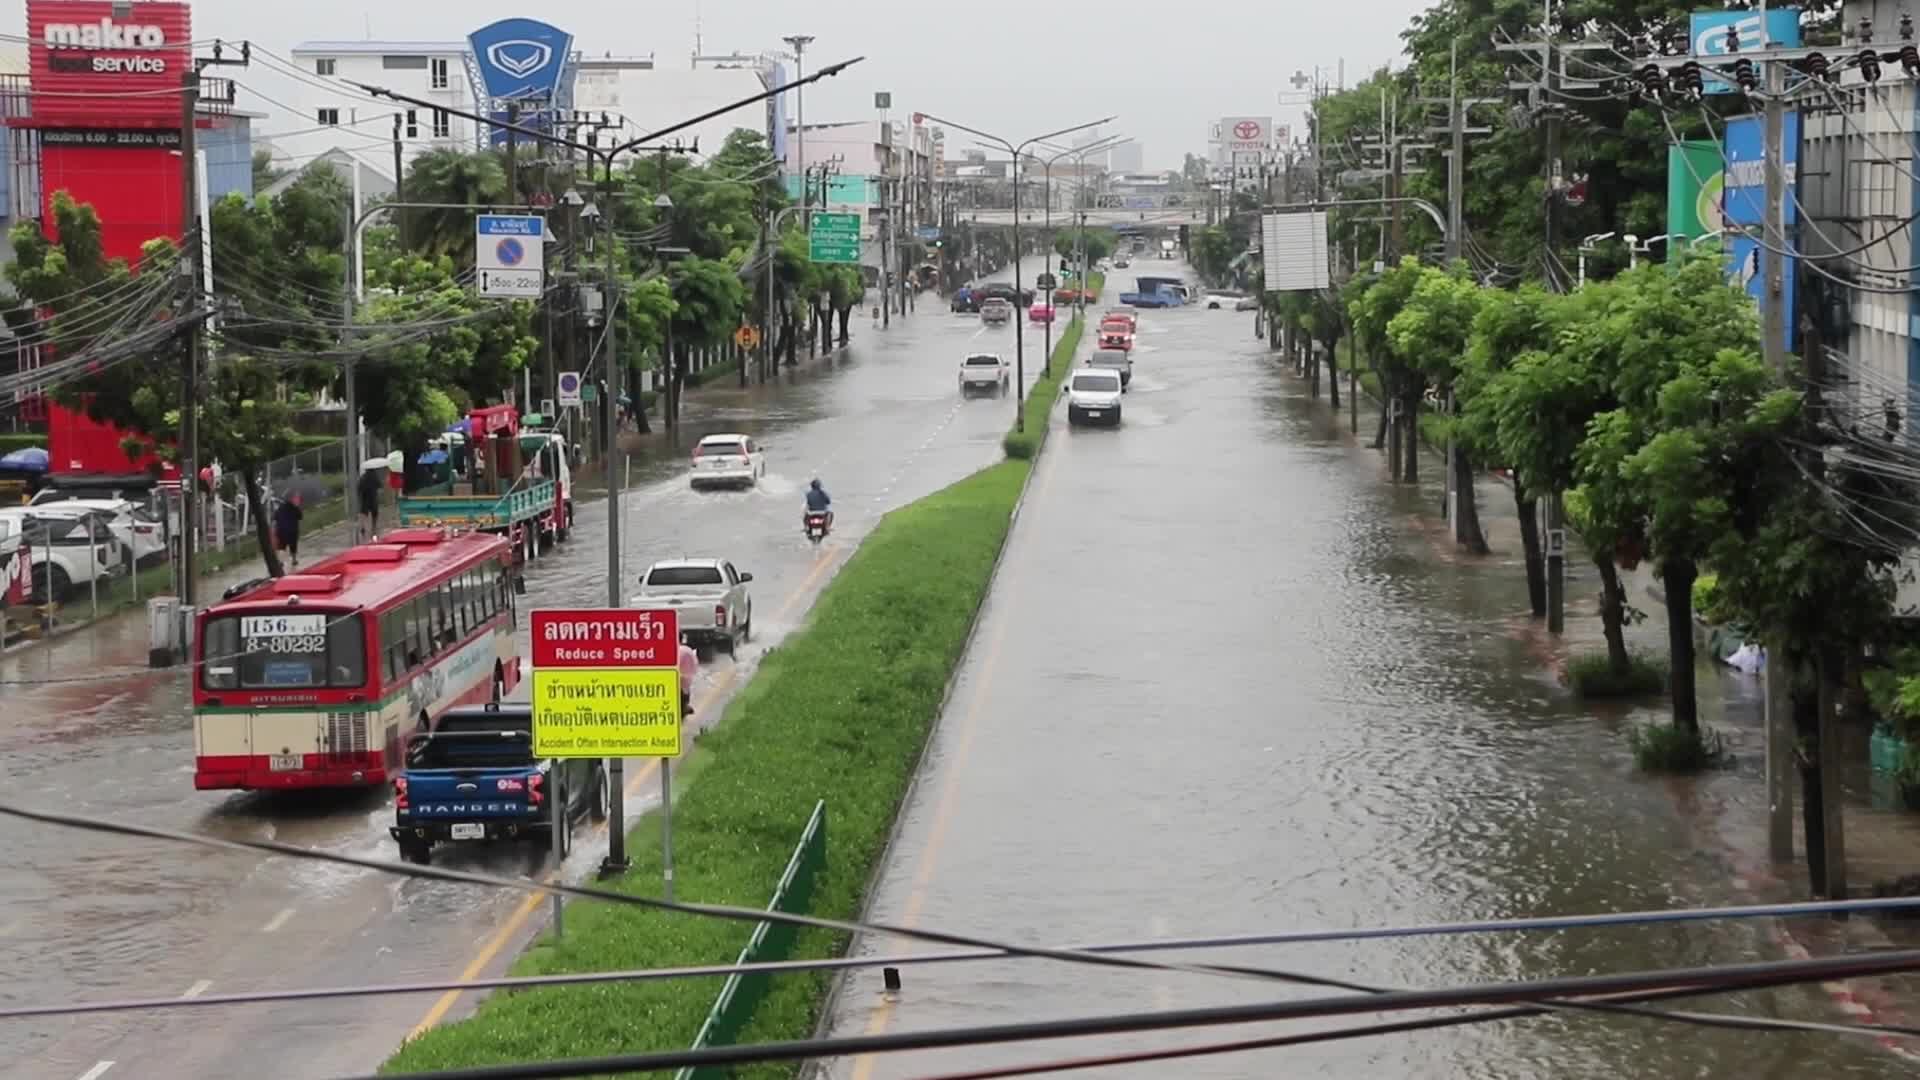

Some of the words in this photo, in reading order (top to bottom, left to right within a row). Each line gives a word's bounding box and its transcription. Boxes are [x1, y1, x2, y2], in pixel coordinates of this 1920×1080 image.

[44, 16, 164, 50] makro
[92, 55, 165, 73] service
[544, 612, 664, 640] ลดความเร็ว
[555, 648, 604, 660] Reduce
[613, 647, 655, 661] Speed
[546, 678, 666, 699] ข้างหน้าทางแยก
[538, 700, 675, 732] เกิดอุบัติเหตุบ่อยครั้ง
[540, 738, 574, 748] Accident
[576, 737, 599, 748] Often
[601, 738, 648, 748] Intersection
[651, 737, 676, 748] Ahead
[419, 803, 517, 813] RANGER
